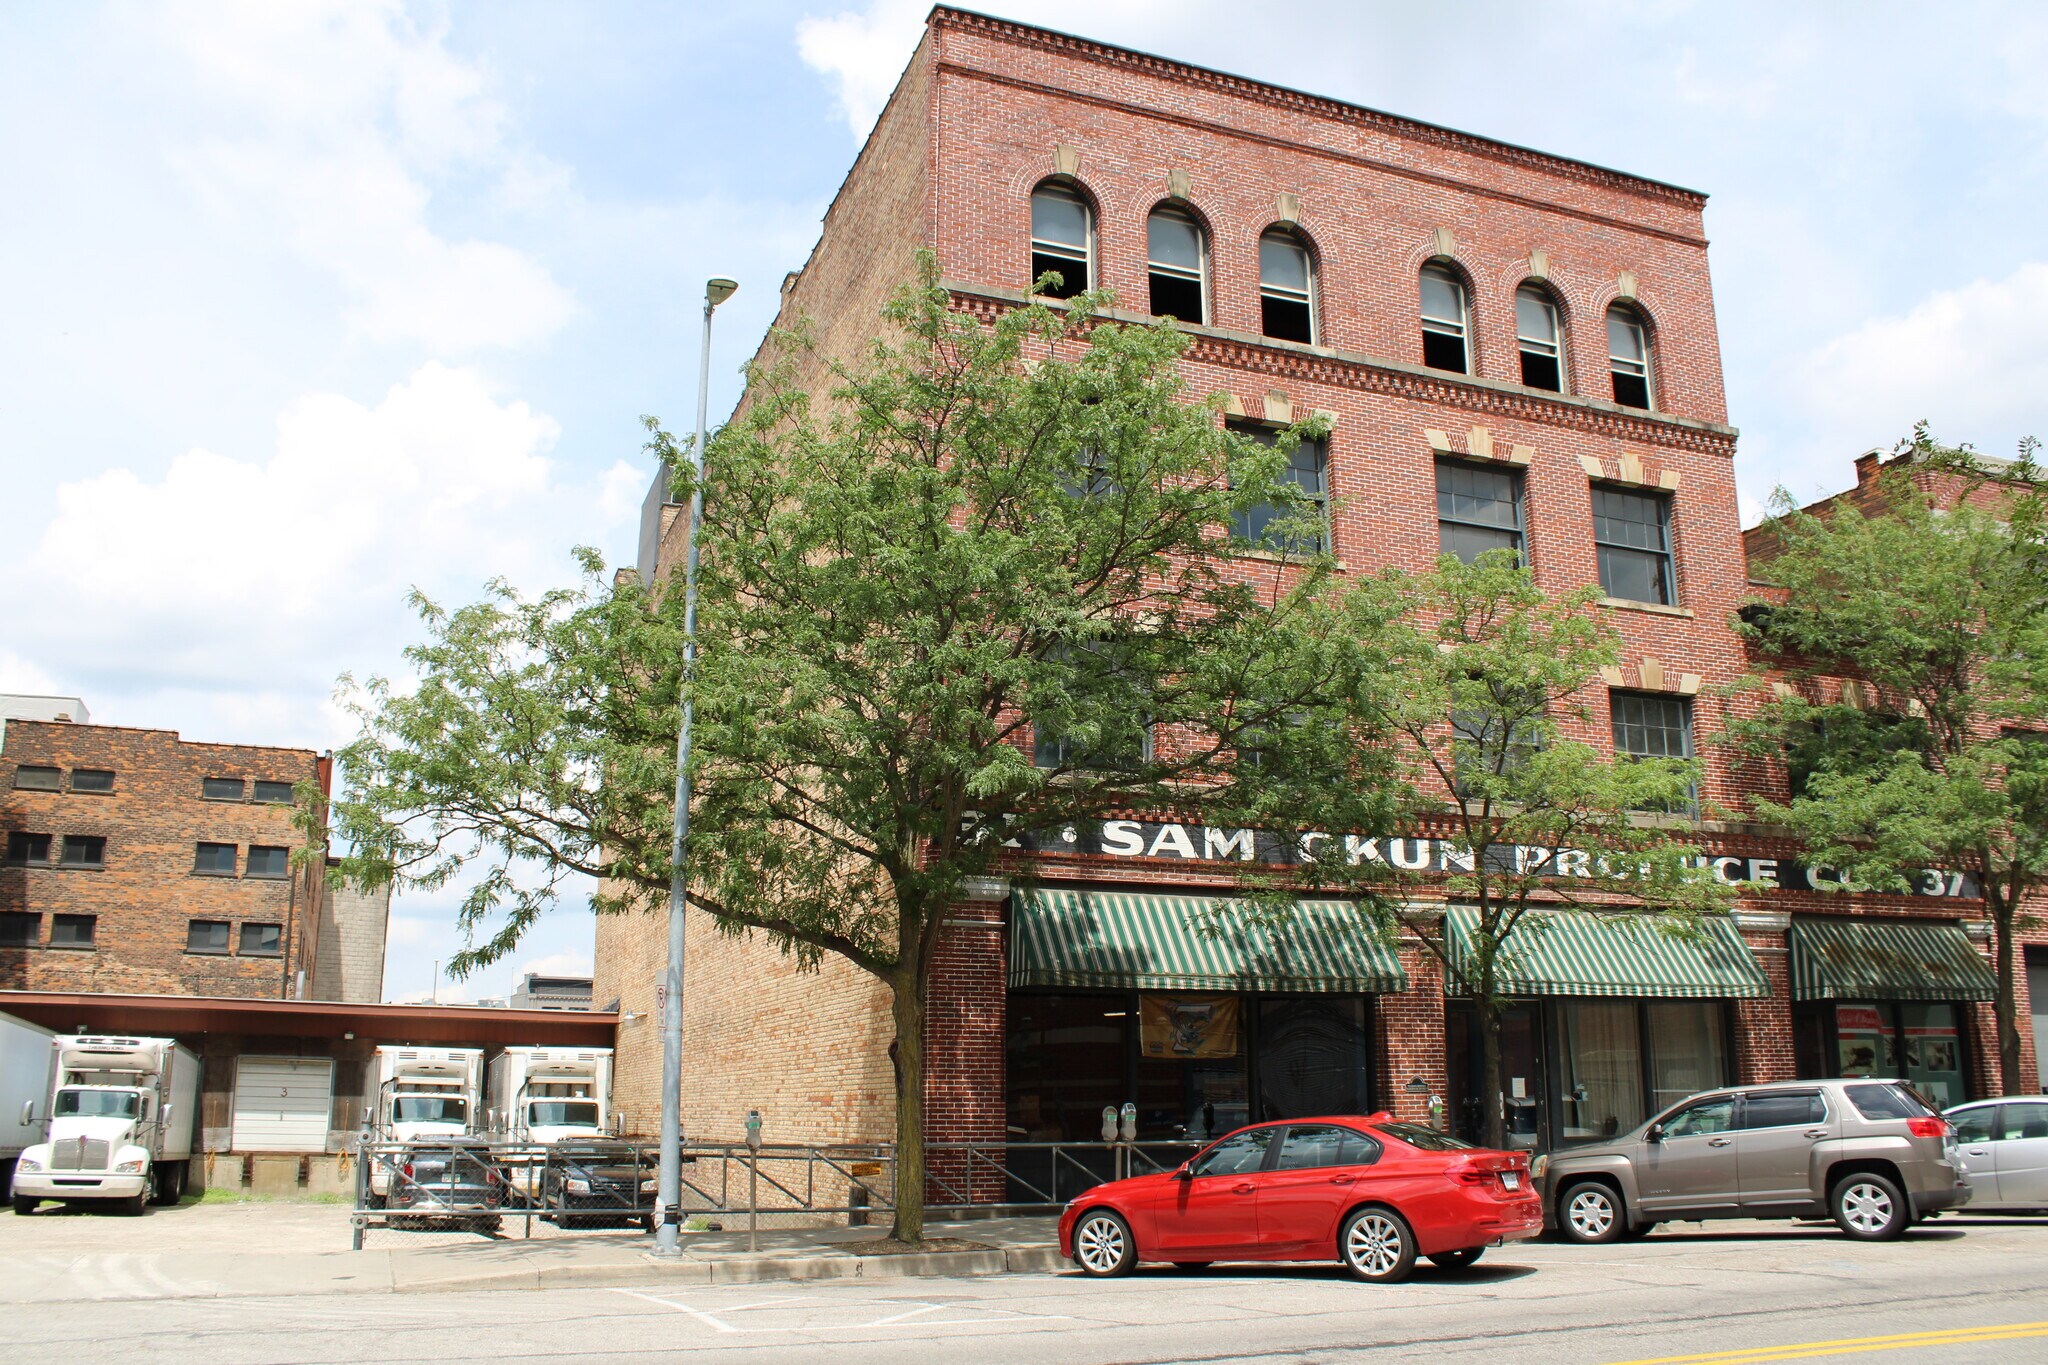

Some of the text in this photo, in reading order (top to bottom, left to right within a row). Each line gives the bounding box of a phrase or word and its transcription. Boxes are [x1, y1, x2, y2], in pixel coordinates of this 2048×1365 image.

[1100, 819, 1255, 862] SAM
[1514, 845, 1780, 888] PROUCE
[1922, 868, 1965, 897] 37
[280, 1086, 288, 1098] 3
